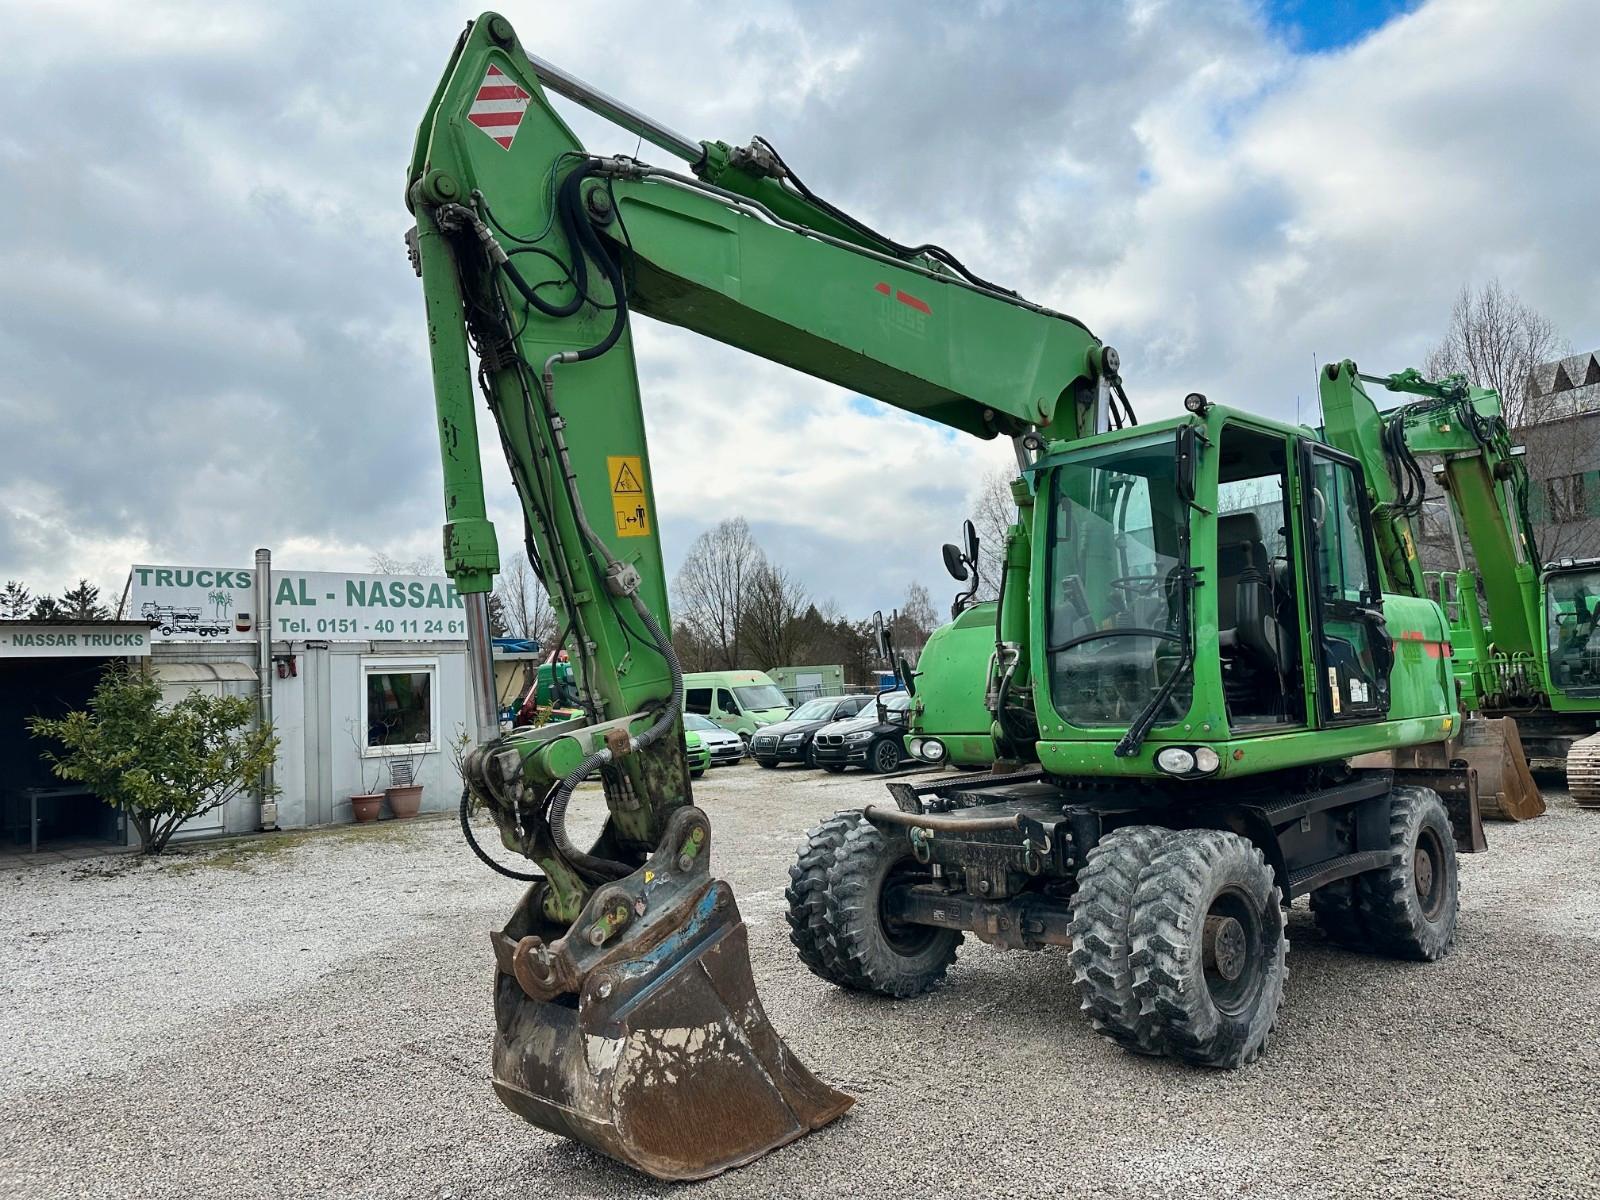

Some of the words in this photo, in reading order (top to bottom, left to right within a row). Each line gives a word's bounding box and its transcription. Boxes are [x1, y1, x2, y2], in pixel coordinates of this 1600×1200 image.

[135, 568, 251, 589] TRUCKS
[274, 577, 317, 606] AL
[346, 580, 465, 609] NASSAR
[278, 618, 311, 633] Tel.
[317, 618, 357, 633] 0151
[374, 619, 394, 633] 40
[400, 620, 418, 633] 11
[424, 620, 443, 633] 24
[448, 620, 465, 634] 61
[12, 634, 77, 647] NASSAR
[82, 634, 144, 647] TRUCKS
